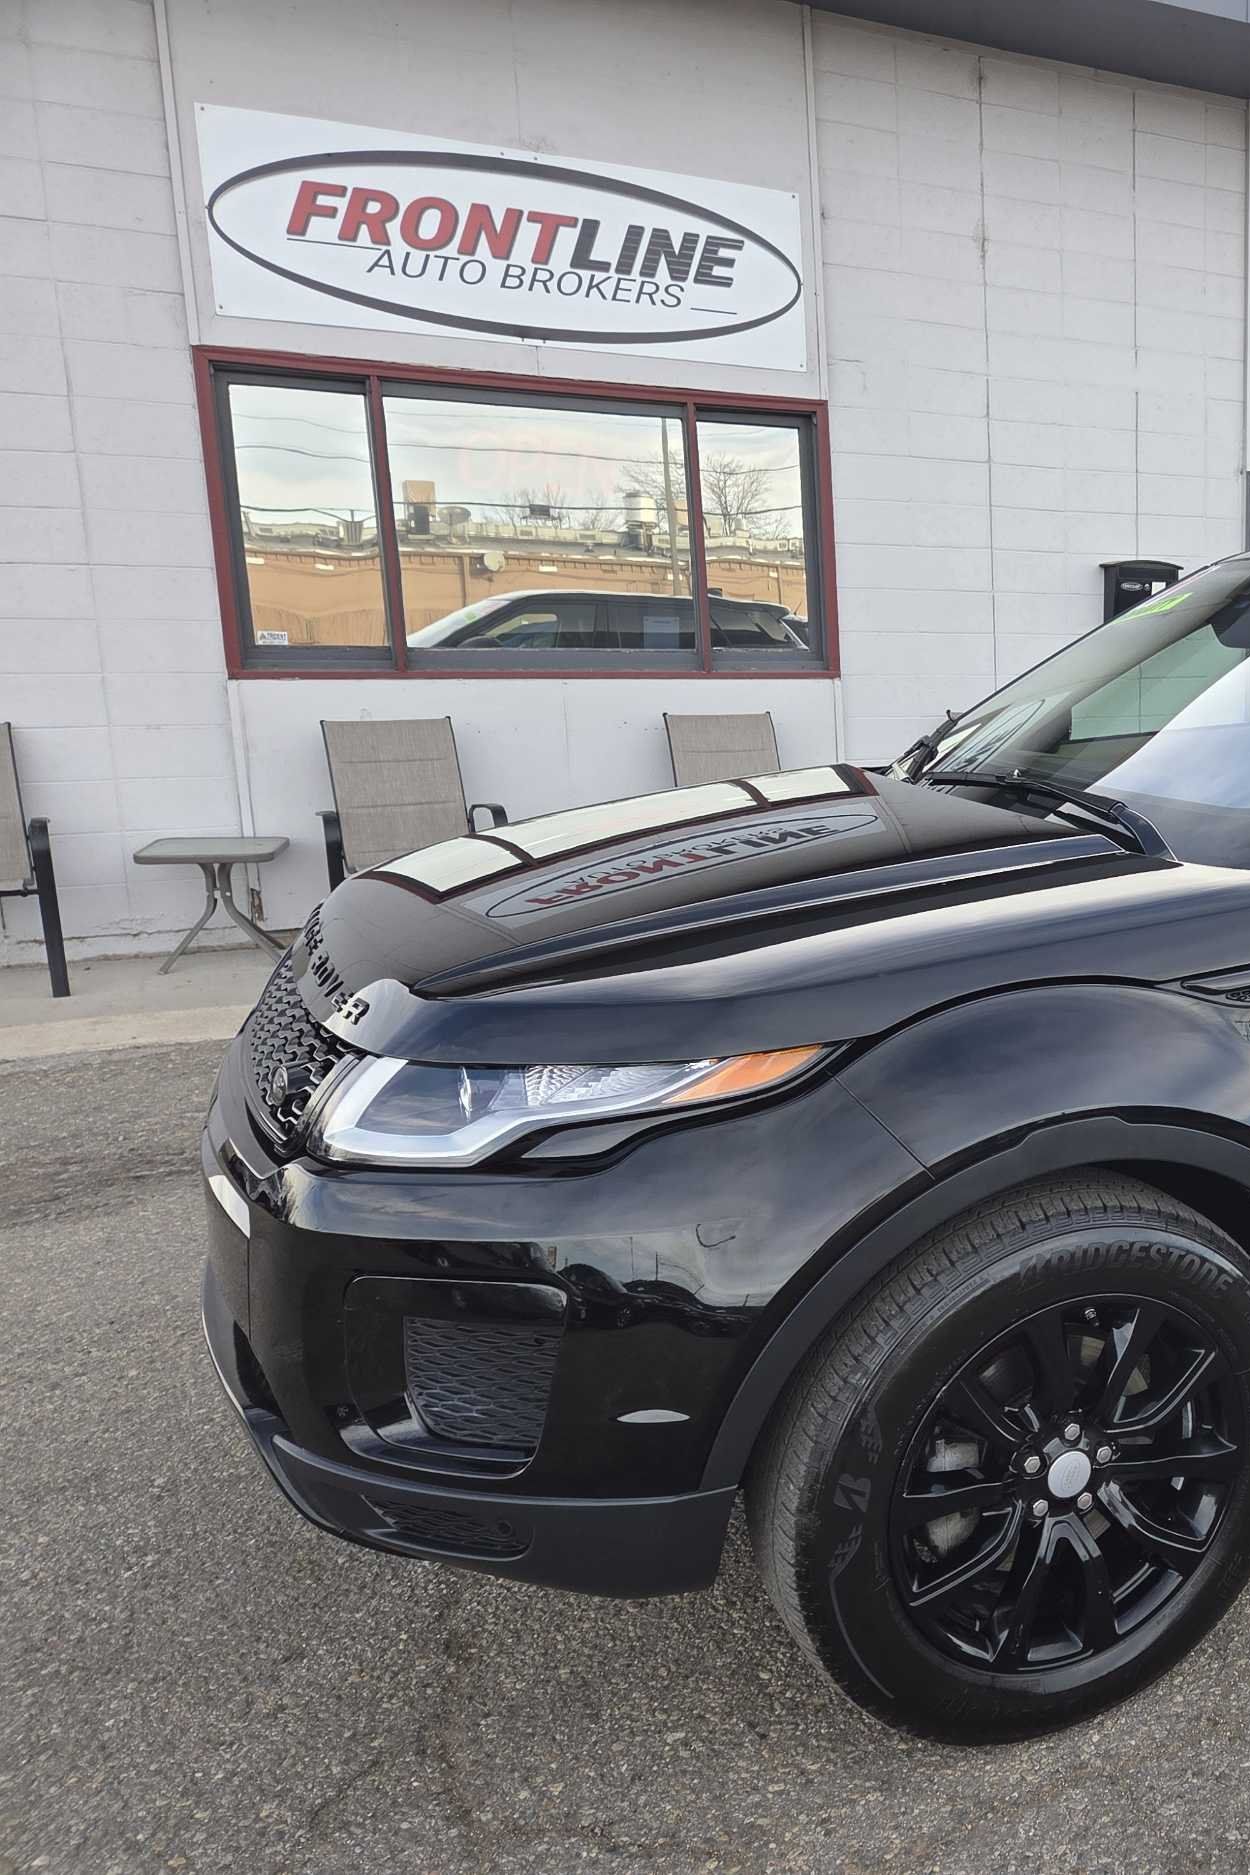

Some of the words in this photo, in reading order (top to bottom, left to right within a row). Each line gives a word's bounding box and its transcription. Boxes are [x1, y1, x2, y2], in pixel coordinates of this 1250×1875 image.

[285, 180, 745, 289] FRONTLINE
[366, 246, 487, 287] AUTO
[499, 263, 686, 309] BROKERS
[1018, 1239, 1235, 1294] BRIDGESTONE
